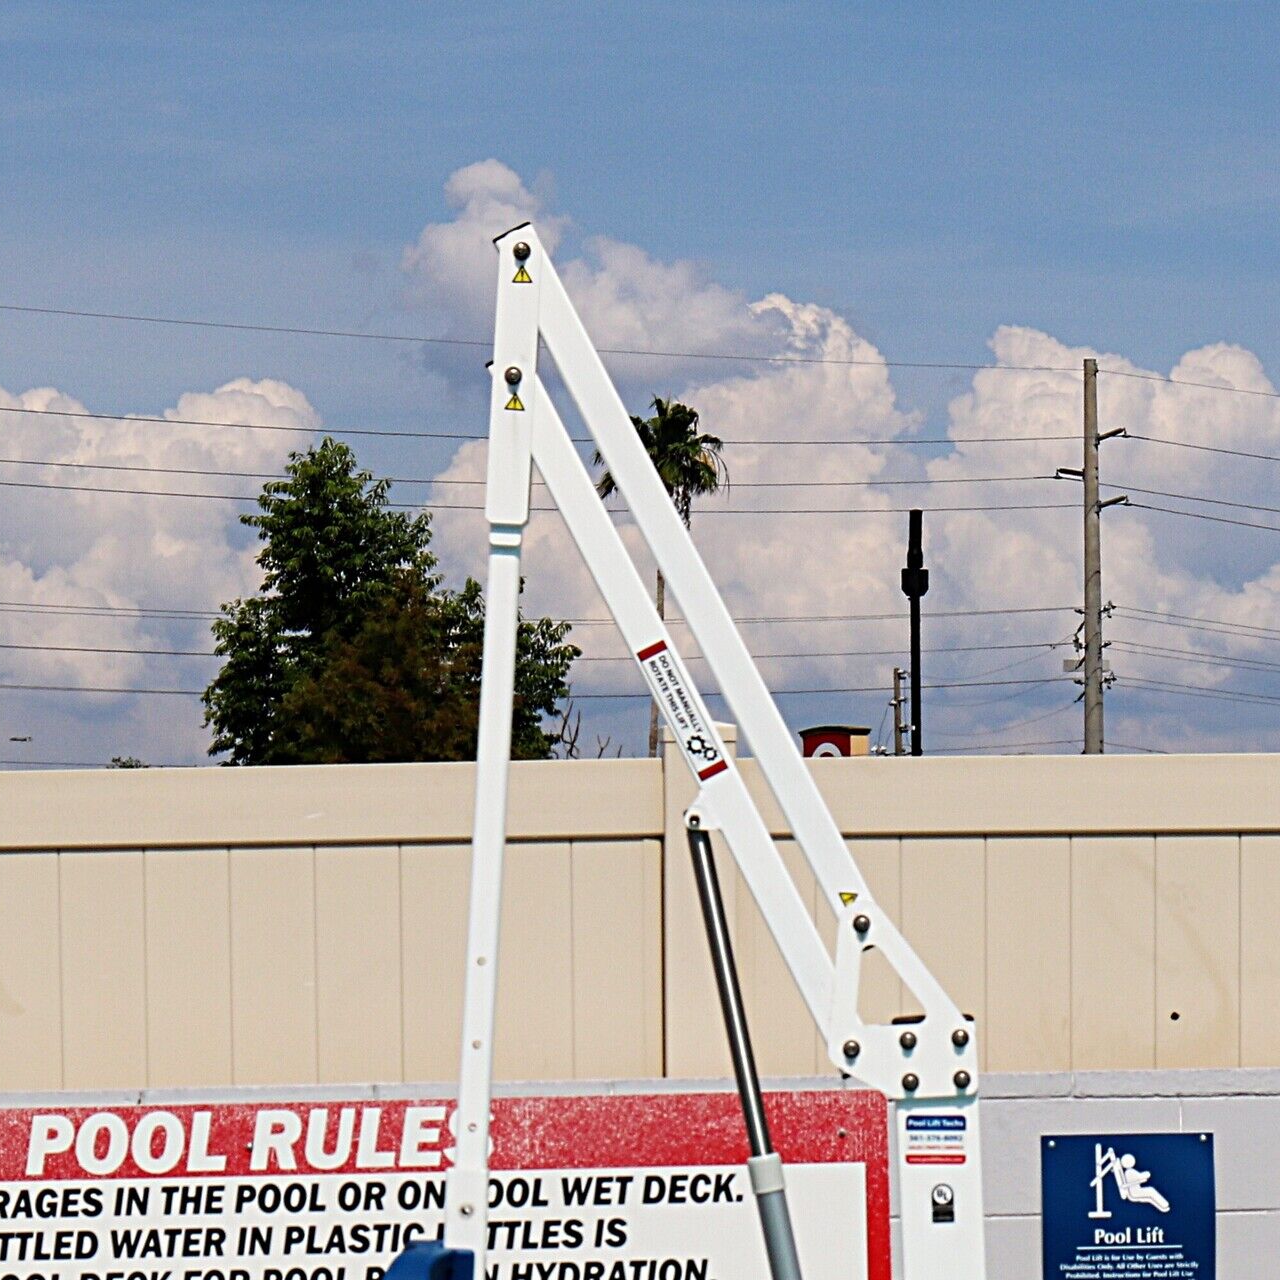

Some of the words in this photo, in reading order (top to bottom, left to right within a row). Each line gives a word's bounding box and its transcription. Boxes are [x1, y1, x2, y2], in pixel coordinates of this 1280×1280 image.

[649, 661, 669, 692] ROTATE
[666, 693, 679, 712] THIS
[675, 710, 689, 730] LIFT
[659, 655, 669, 669] DO
[667, 668, 679, 686] NOT
[677, 687, 704, 734] MANUALLY
[25, 1110, 228, 1177] POOL
[114, 1187, 149, 1216] IN
[162, 1186, 225, 1215] THE
[235, 1183, 325, 1213] POOL
[339, 1182, 386, 1211] OR
[398, 1181, 448, 1210] ON
[562, 1176, 633, 1205] WET
[643, 1173, 744, 1205] DECK.
[111, 1228, 226, 1258] WATER
[238, 1227, 272, 1255] IN
[284, 1223, 425, 1254] PLASTIC
[595, 1219, 626, 1247] IS
[1094, 1227, 1131, 1244] Pool
[1137, 1226, 1164, 1243] Lift
